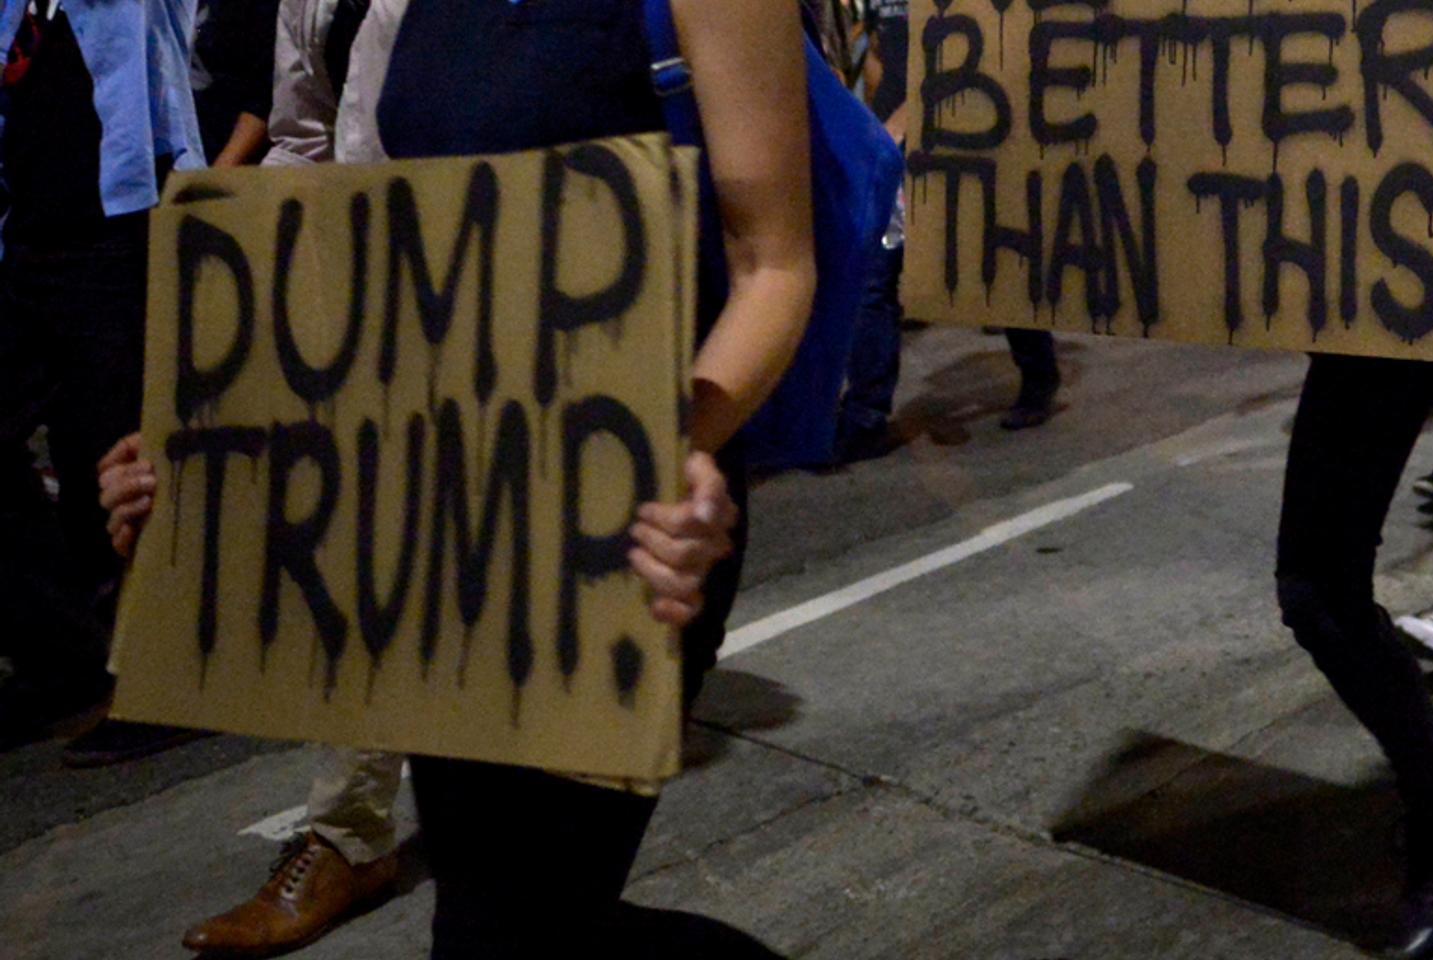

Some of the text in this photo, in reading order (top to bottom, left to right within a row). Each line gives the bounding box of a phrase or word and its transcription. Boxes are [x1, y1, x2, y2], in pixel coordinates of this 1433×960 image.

[173, 144, 647, 426] DUMP
[908, 152, 1160, 330] THAN
[164, 394, 659, 705] TRUMP.
